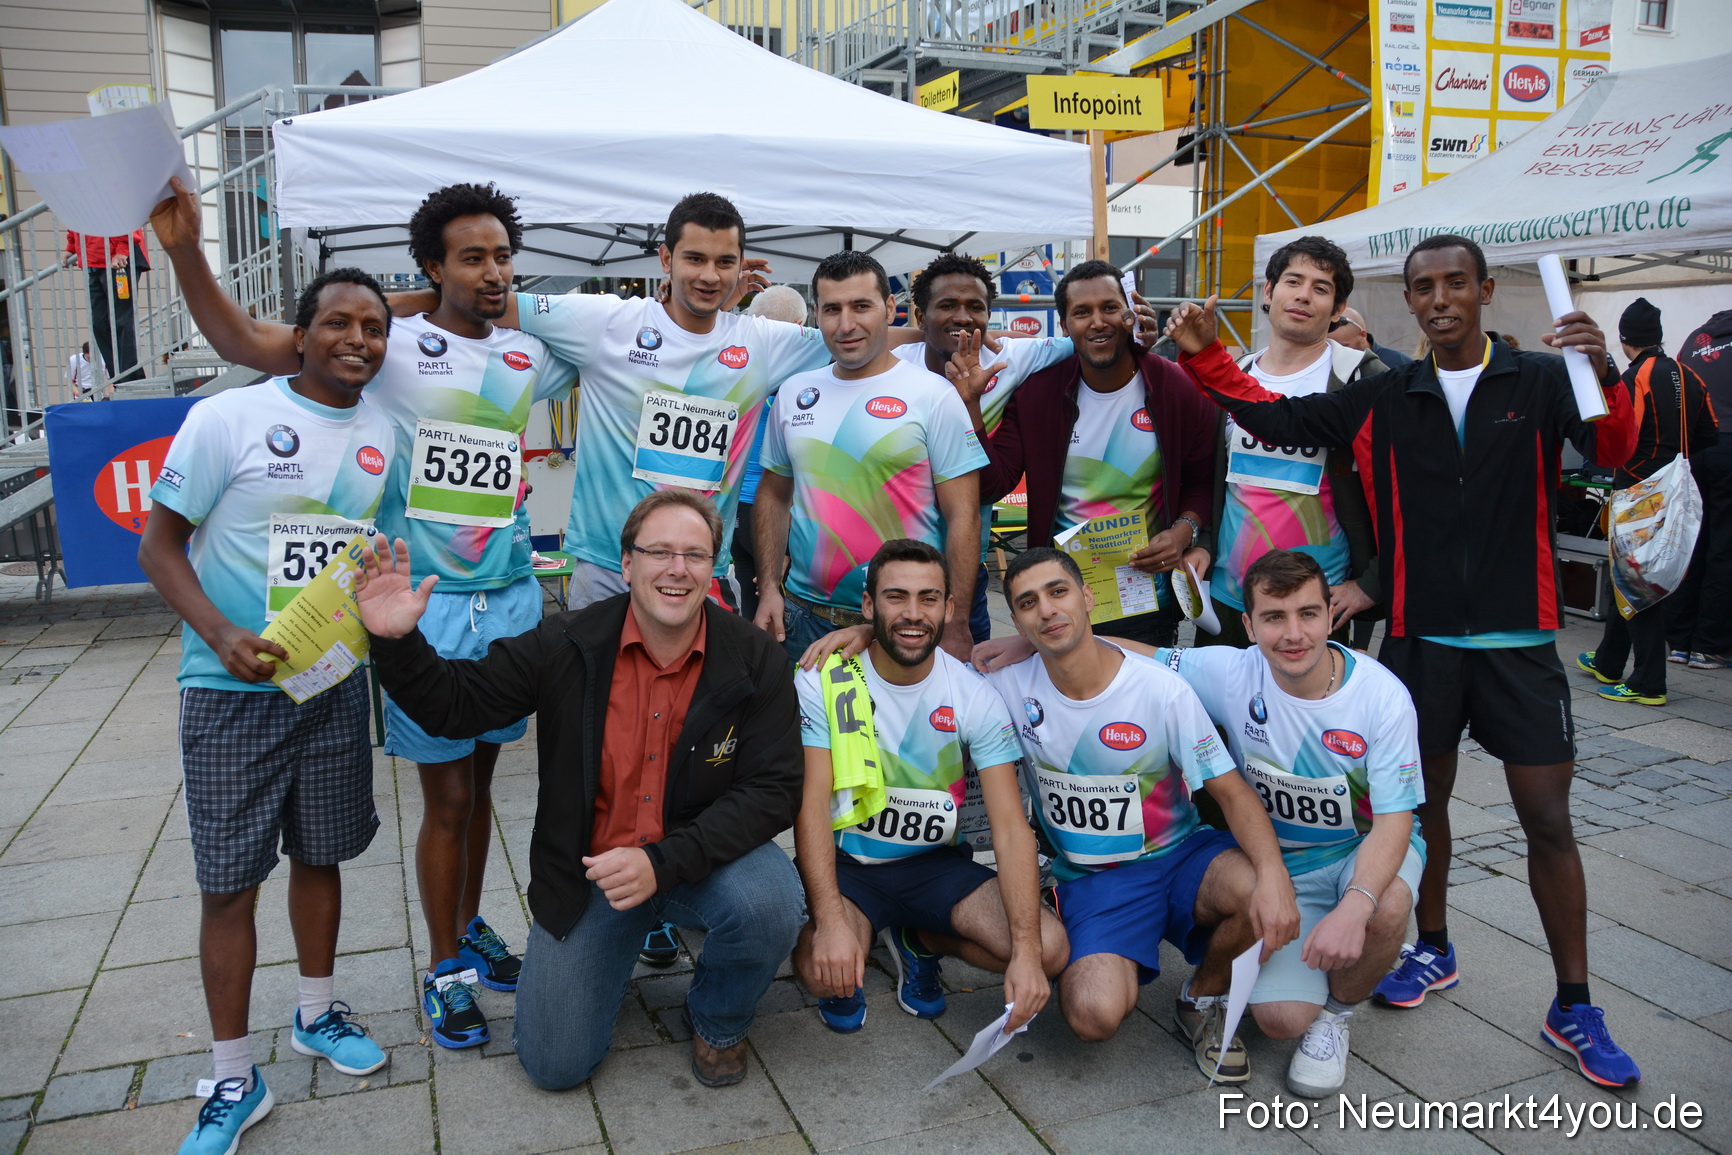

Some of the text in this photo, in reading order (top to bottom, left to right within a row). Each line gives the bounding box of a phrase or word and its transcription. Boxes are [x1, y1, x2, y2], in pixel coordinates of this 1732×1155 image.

[1438, 5, 1490, 18] Neumarkter Tagblatt
[1522, 0, 1555, 10] Egner
[1435, 67, 1488, 91] Charivari
[1508, 71, 1546, 94] Hervis
[919, 87, 951, 108] Toiletten
[1053, 91, 1142, 119] Infopoint
[1430, 138, 1468, 152] swn
[1111, 203, 1142, 214] Markt 15
[1013, 321, 1040, 333] Hervis
[628, 357, 659, 368] Neumarkt
[629, 350, 659, 362] PARTL
[723, 351, 747, 364] Hervis
[418, 361, 453, 370] PARTL
[646, 396, 726, 418] PARTL Neumarkt
[871, 400, 902, 414] Hervis
[791, 420, 814, 428] Neumarkt
[792, 413, 815, 422] PARTL
[418, 428, 505, 450] PARTL Neumarkt
[649, 412, 728, 456] 3084
[267, 462, 303, 473] PARTL
[361, 451, 384, 468] Hervis
[267, 471, 303, 480] Neumarkt
[424, 445, 512, 491] 5328
[273, 524, 363, 535] PARTL Neumarkt
[1088, 528, 1142, 544] Neumarkter
[1089, 536, 1132, 550] Stadtlauf
[331, 562, 355, 594] 16.
[1106, 728, 1141, 744] Hervis
[1245, 722, 1269, 740] PARTL
[1327, 733, 1362, 753] Hervis
[1039, 775, 1120, 793] PARTL Neumarkt
[1246, 764, 1329, 795] PARTL Neumarkt
[889, 795, 940, 809] Neumarkt
[1255, 781, 1342, 827] 3089
[1048, 792, 1130, 831] 3087
